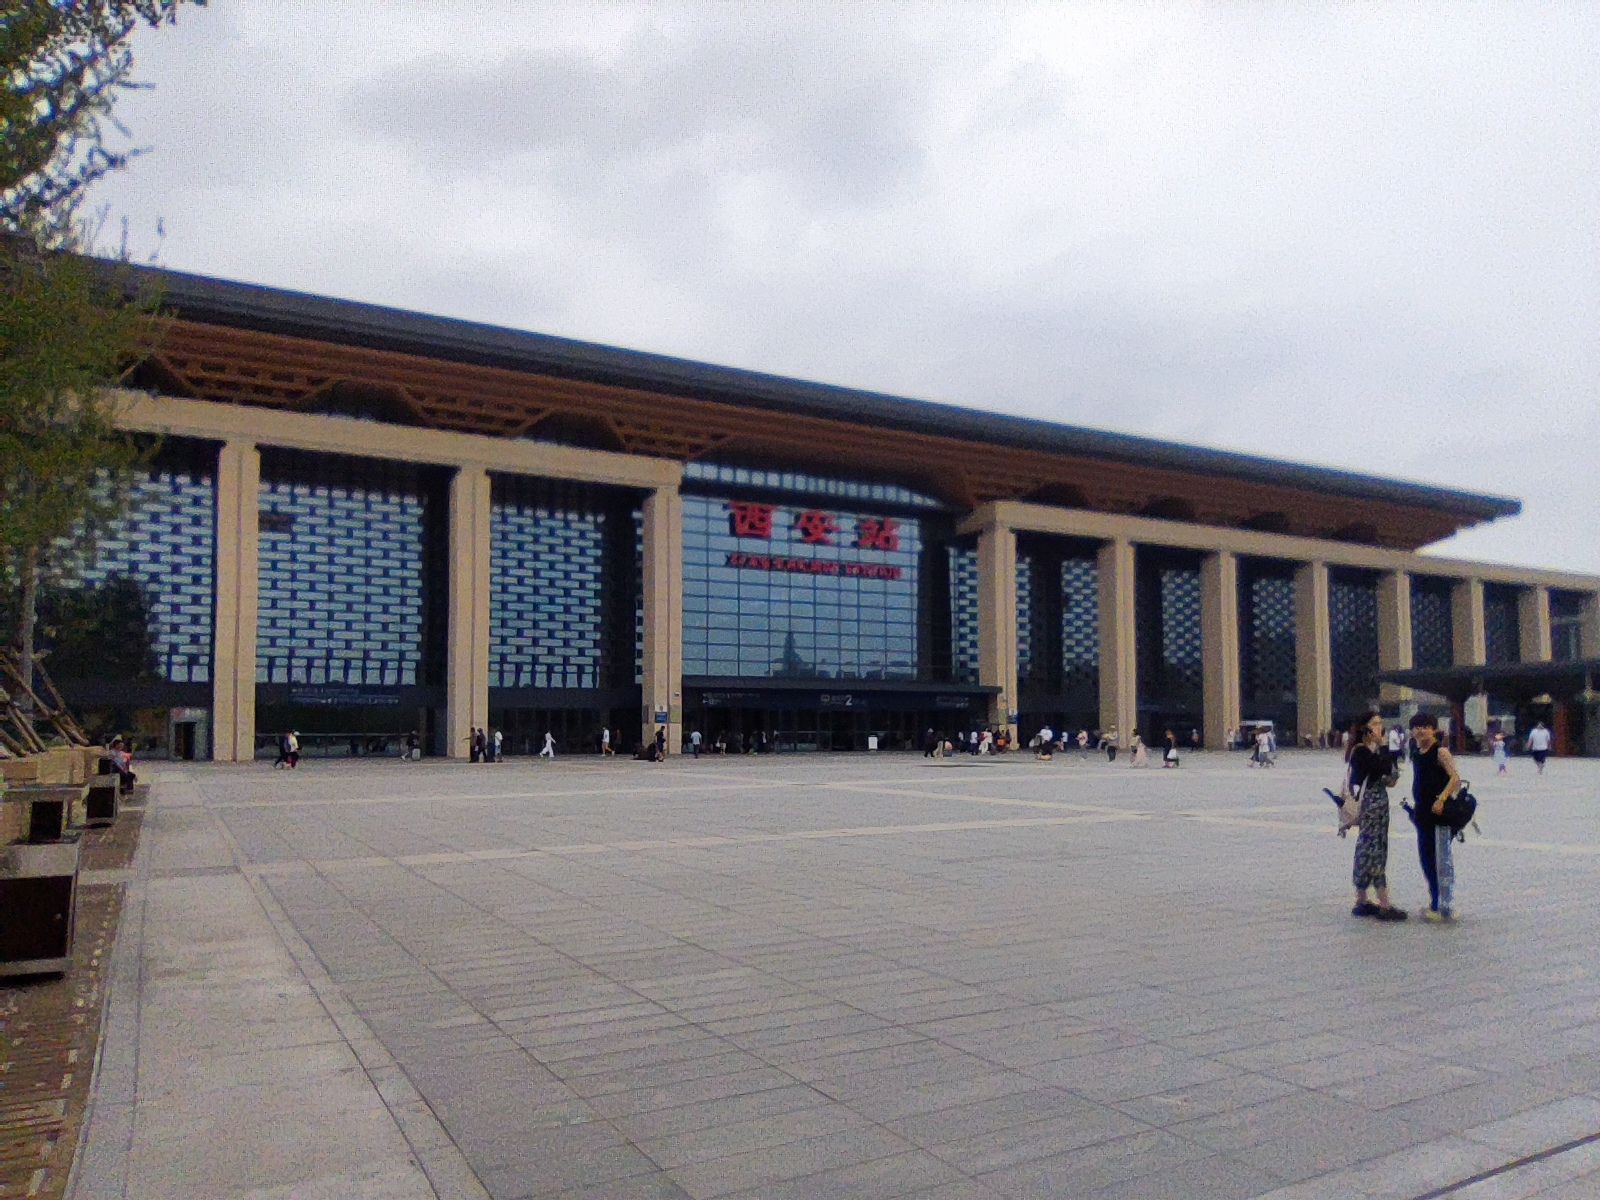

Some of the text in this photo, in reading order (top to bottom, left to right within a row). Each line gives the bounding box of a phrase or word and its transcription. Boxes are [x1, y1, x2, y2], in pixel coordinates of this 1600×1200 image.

[728, 500, 898, 550] 西安站
[845, 694, 853, 706] 2
